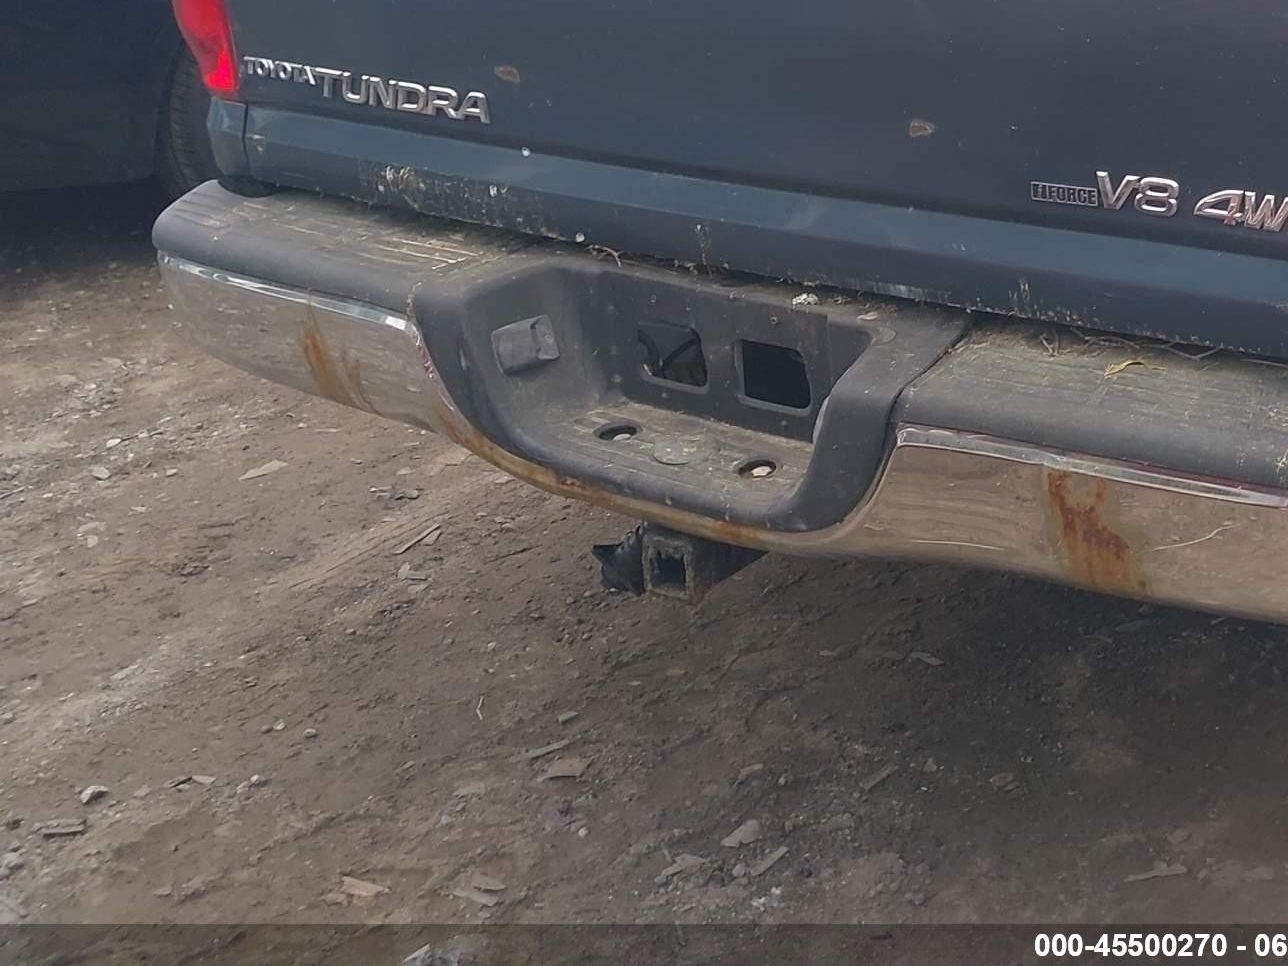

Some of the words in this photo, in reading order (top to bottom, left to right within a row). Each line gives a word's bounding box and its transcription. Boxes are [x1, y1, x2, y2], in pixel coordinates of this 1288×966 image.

[243, 56, 316, 85] TOYOTA
[315, 67, 491, 124] TUNDRA
[1096, 171, 1180, 217] V8
